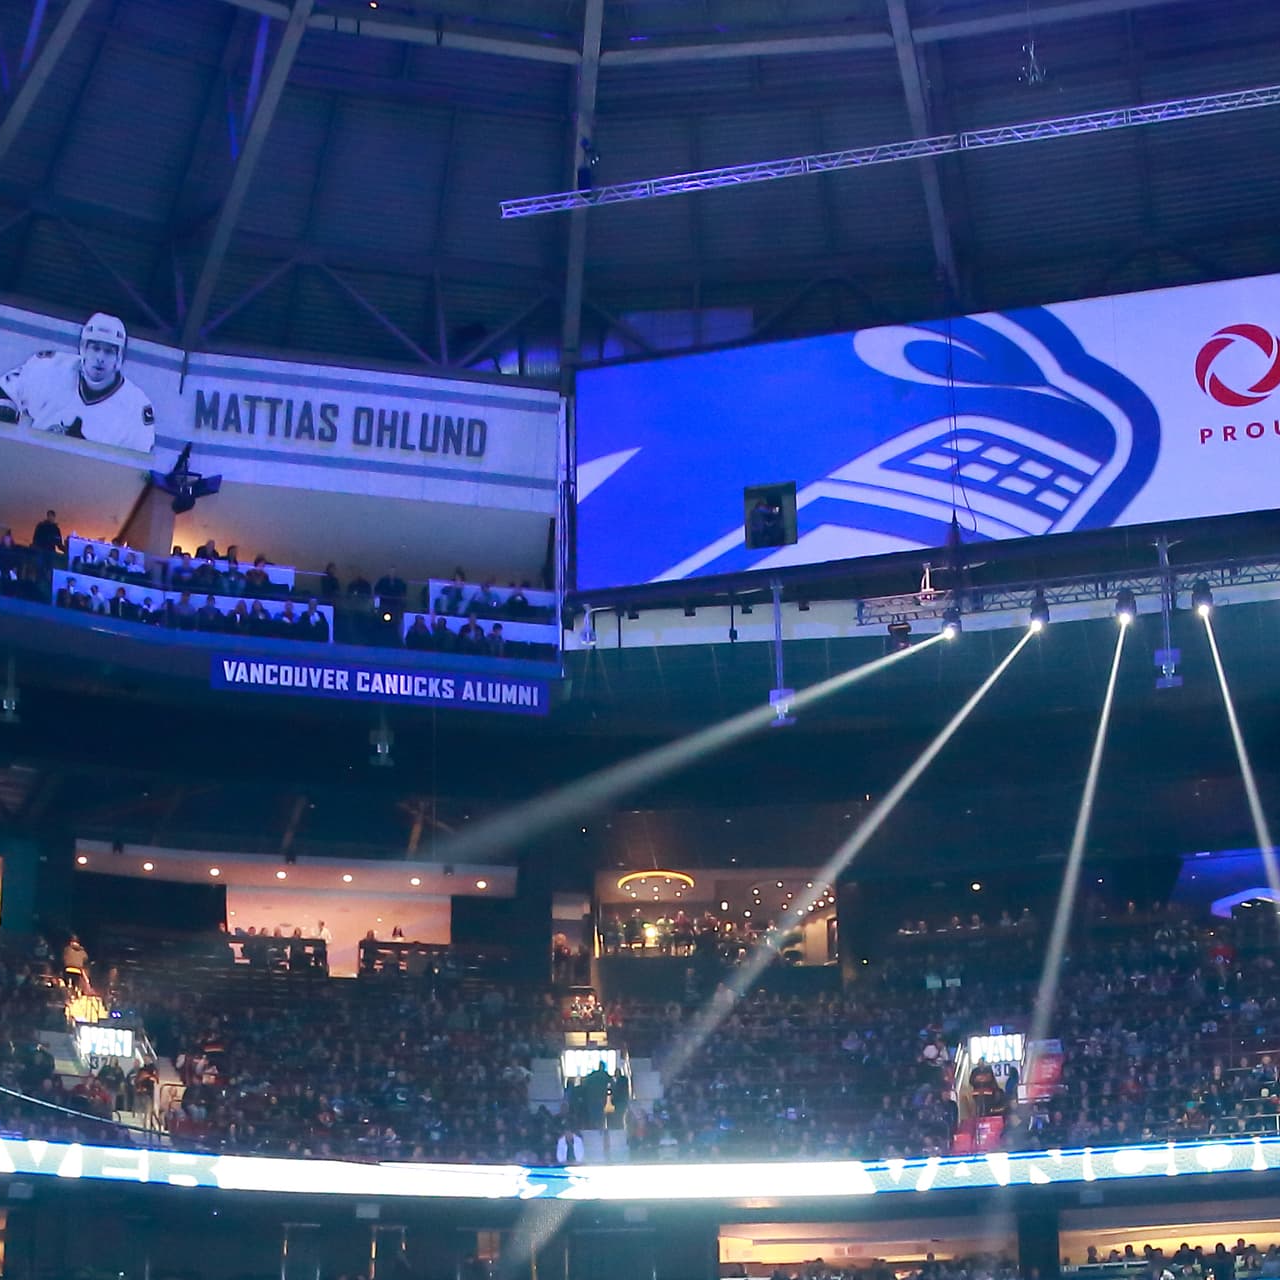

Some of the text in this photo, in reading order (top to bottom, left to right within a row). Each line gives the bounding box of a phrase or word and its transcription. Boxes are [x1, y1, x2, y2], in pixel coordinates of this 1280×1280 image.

[195, 389, 488, 459] MATTIAS OHLUND
[223, 659, 539, 706] VANCOUVER CANUCKS ALUMNI
